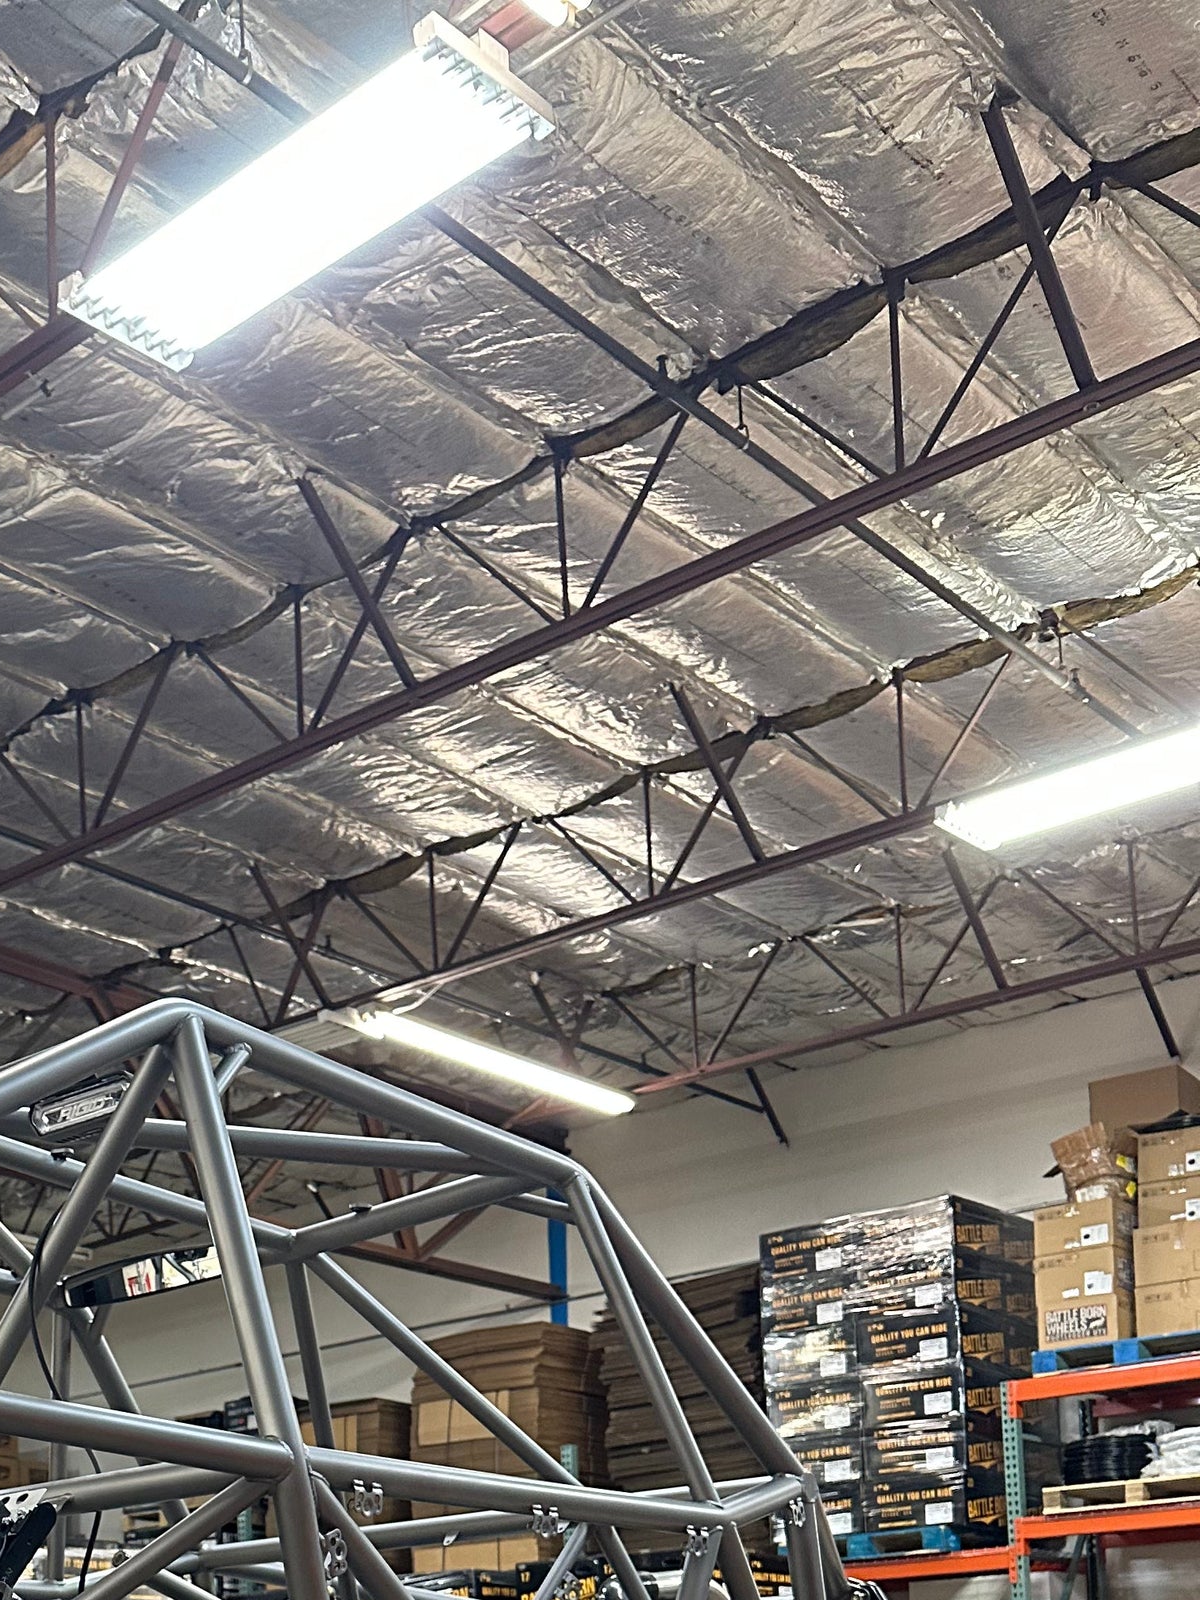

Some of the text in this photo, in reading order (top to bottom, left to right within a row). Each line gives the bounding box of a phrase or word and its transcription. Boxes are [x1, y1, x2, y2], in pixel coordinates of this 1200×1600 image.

[57, 1096, 106, 1122] RIGID
[1046, 1304, 1107, 1323] BATTLE BORN
[1046, 1318, 1088, 1335] WHEELS
[871, 1331, 899, 1344] QUALITY
[876, 1493, 905, 1504] QUALITY
